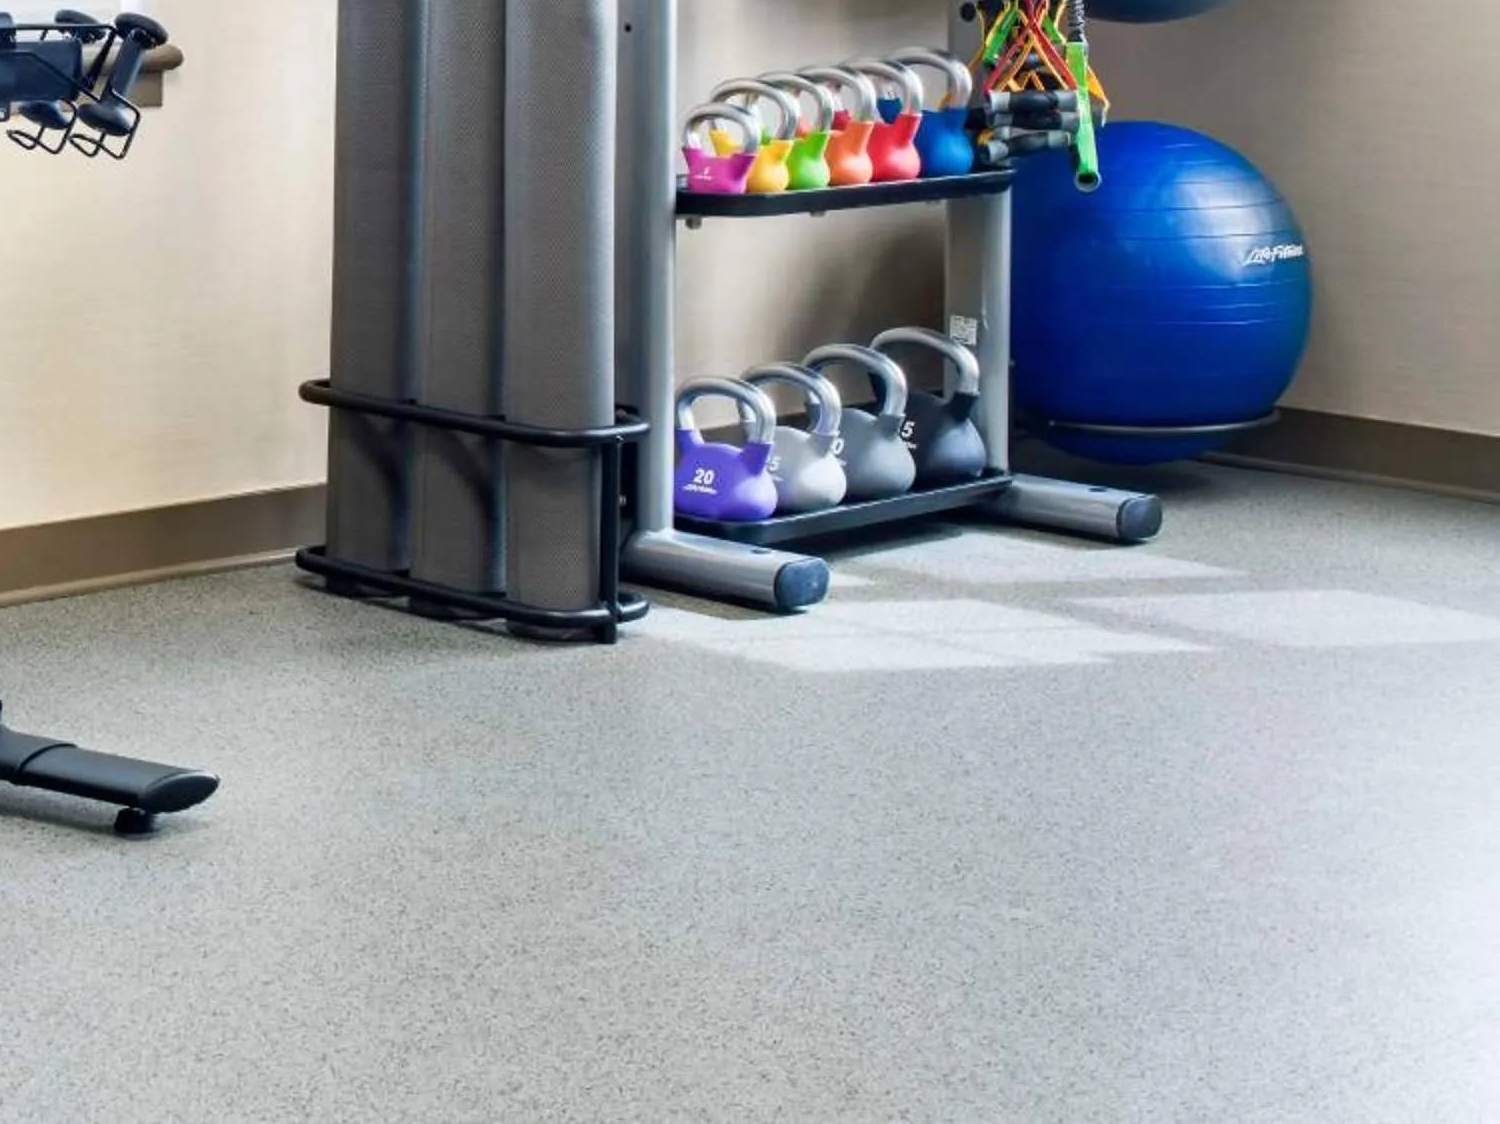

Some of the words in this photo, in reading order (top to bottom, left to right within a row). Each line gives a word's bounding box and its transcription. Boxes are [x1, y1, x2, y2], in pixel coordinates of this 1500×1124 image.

[900, 420, 916, 438] 5
[831, 437, 845, 455] 0
[693, 467, 715, 485] 20
